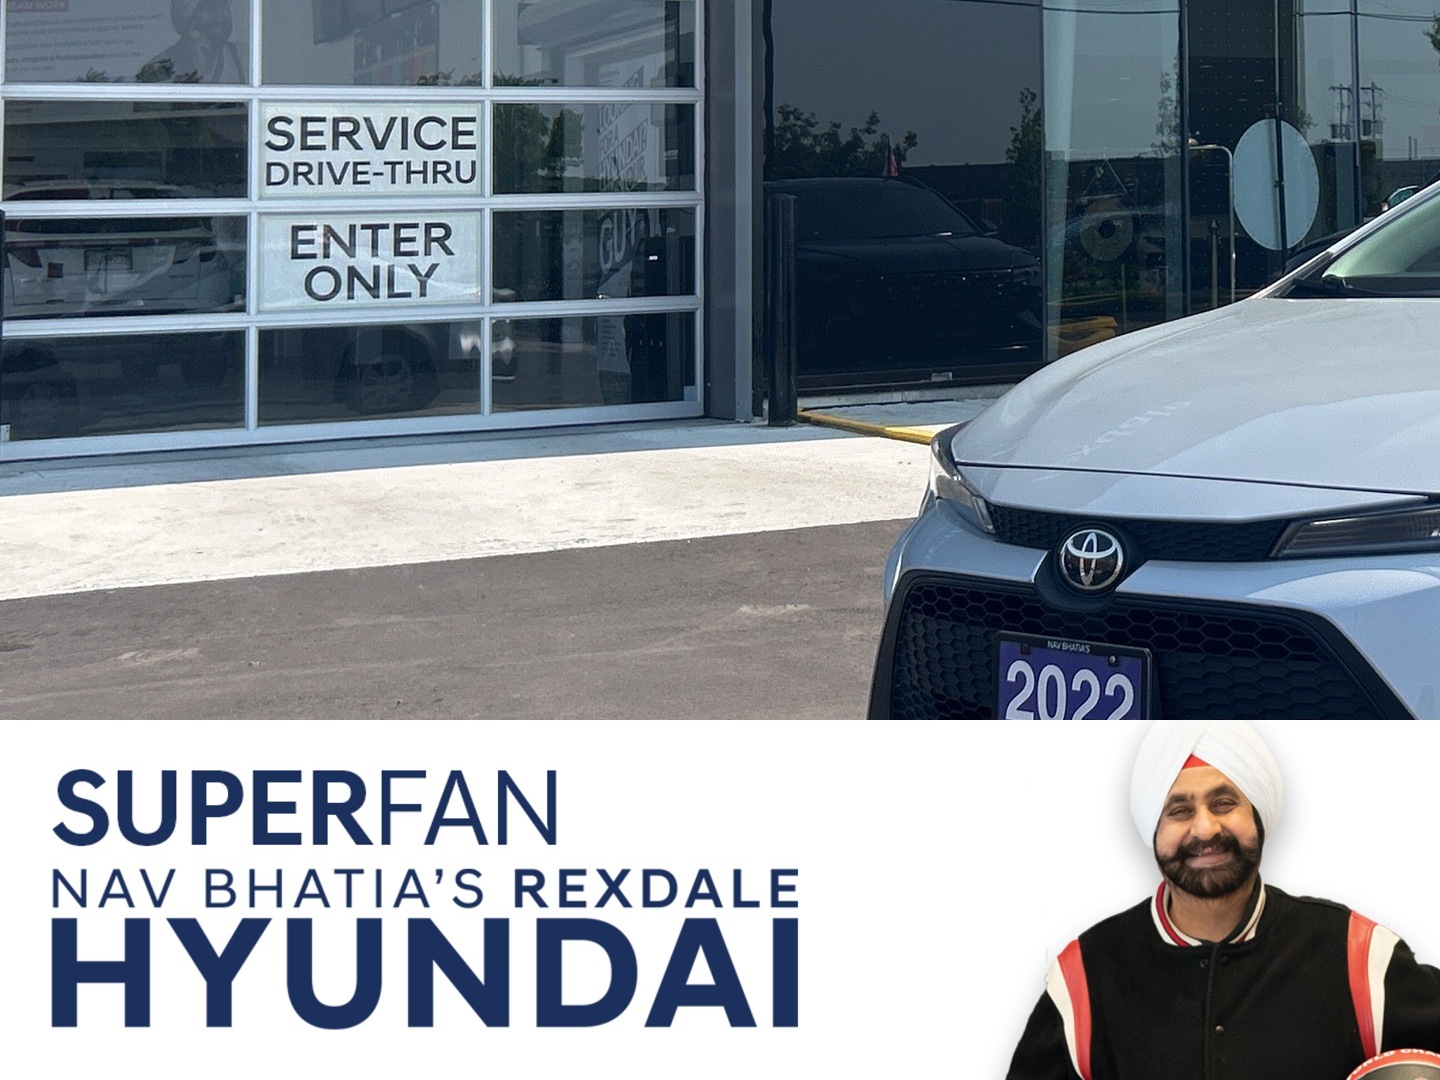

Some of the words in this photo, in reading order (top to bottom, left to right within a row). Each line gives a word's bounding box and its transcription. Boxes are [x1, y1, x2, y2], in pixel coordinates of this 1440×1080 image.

[265, 116, 477, 152] SERVICE
[266, 159, 477, 186] DRIVE-THRU
[290, 222, 455, 260] ENTER
[304, 263, 440, 301] ONLY
[1005, 659, 1134, 720] 2022
